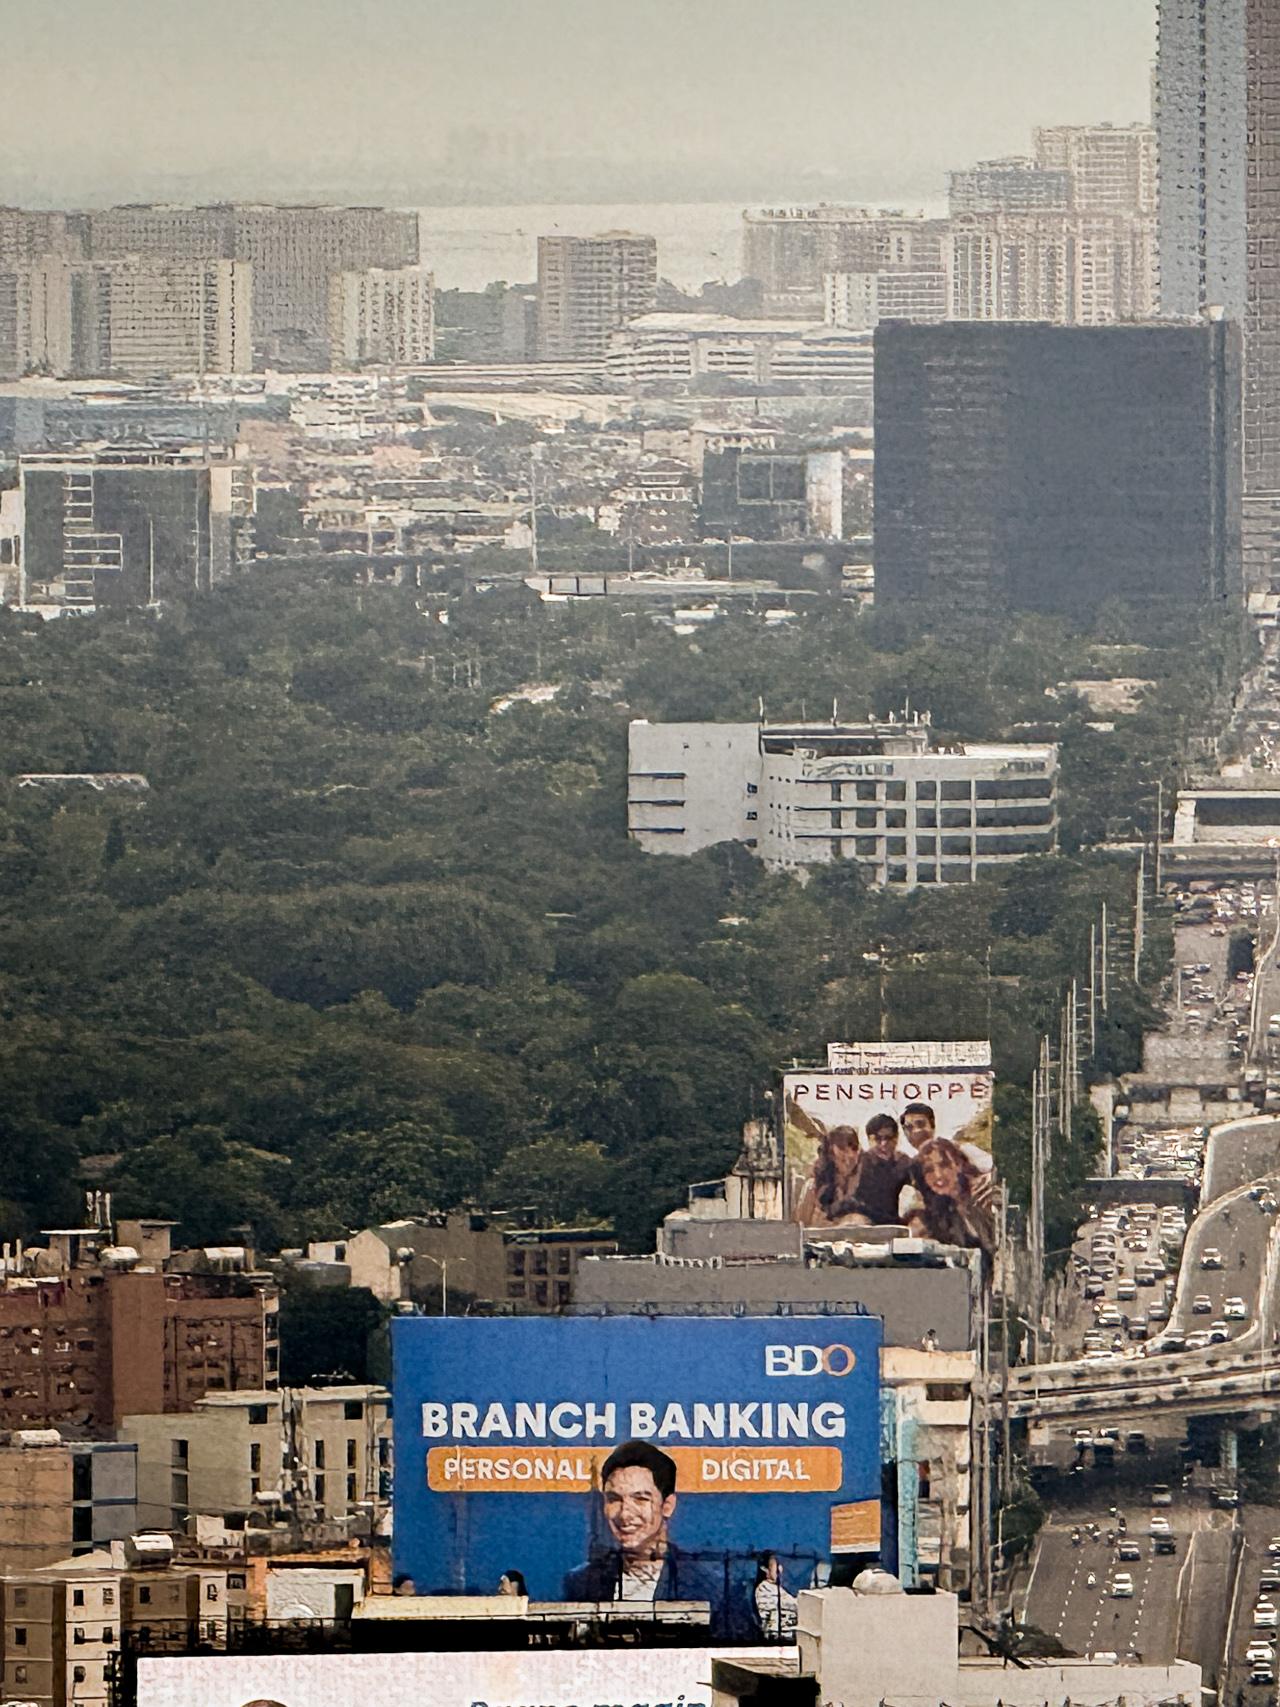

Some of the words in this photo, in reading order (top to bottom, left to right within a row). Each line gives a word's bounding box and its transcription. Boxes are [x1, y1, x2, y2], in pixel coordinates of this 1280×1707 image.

[793, 1082, 990, 1101] PENSHOPPE
[764, 1343, 856, 1377] BDO
[422, 1402, 616, 1438] BRANCH
[630, 1402, 846, 1439] BANKING
[444, 1457, 592, 1481] PERSONAL
[701, 1457, 811, 1481] DIGITAL
